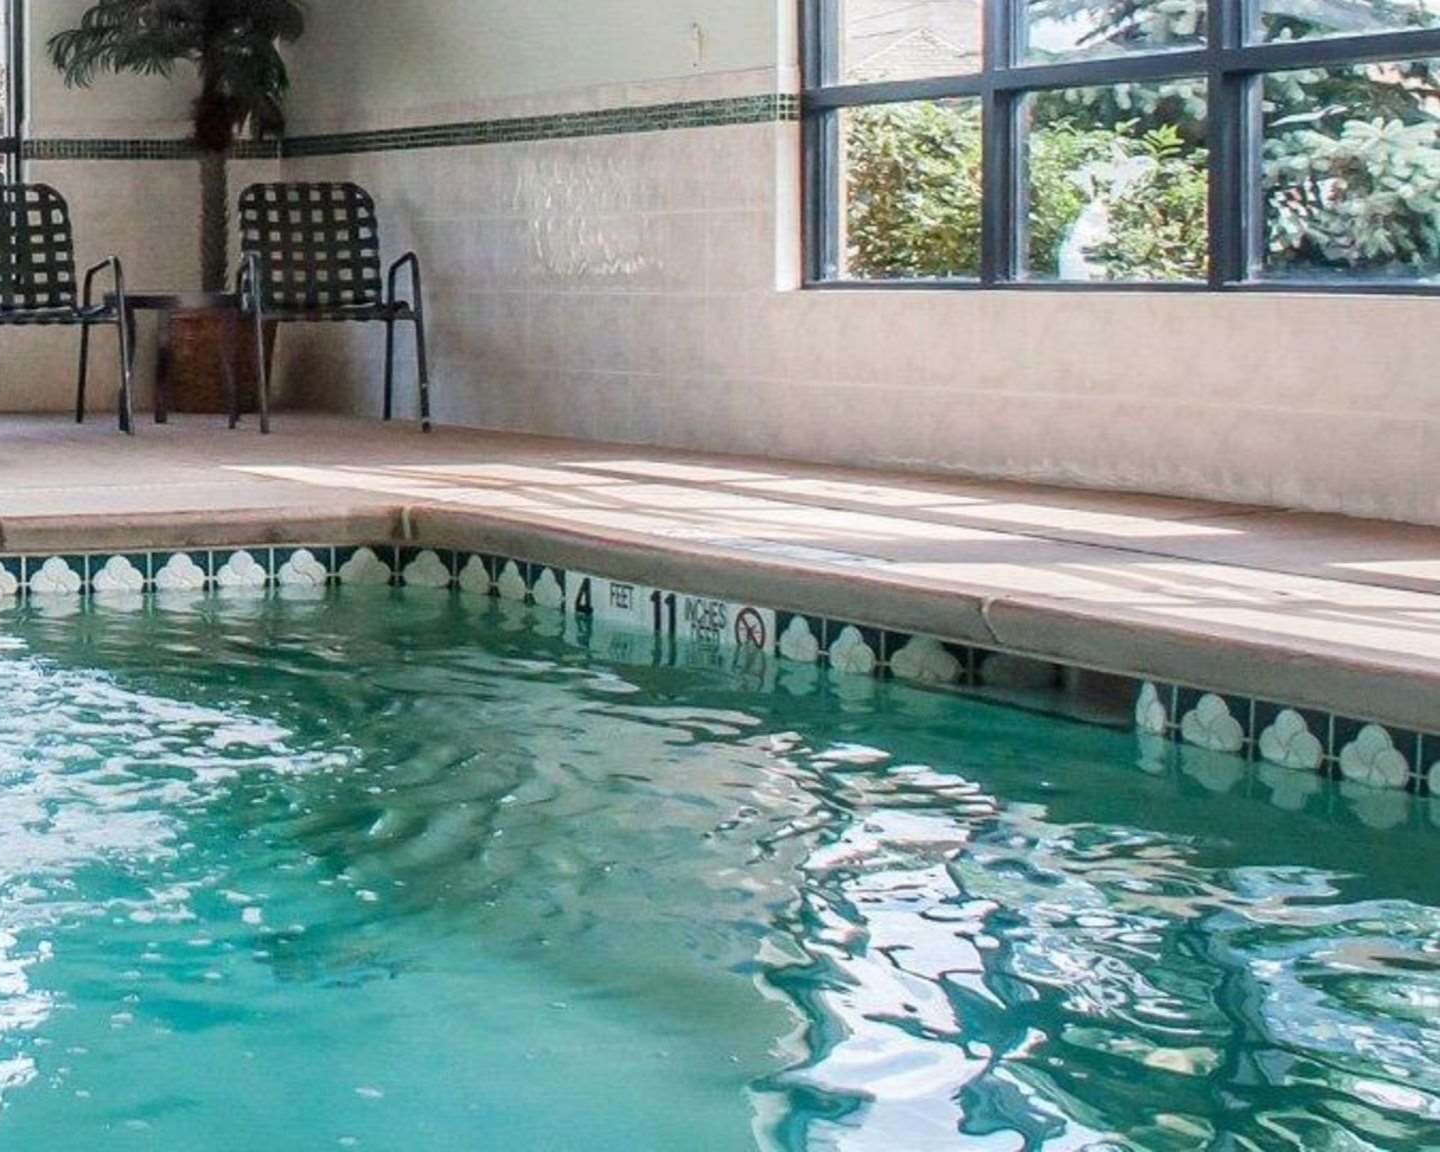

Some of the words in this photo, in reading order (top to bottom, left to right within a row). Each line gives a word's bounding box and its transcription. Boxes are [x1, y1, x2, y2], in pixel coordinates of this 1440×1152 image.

[575, 577, 594, 614] 4
[610, 582, 634, 610] FEET
[650, 589, 677, 636] 11
[684, 597, 727, 629] INCHES
